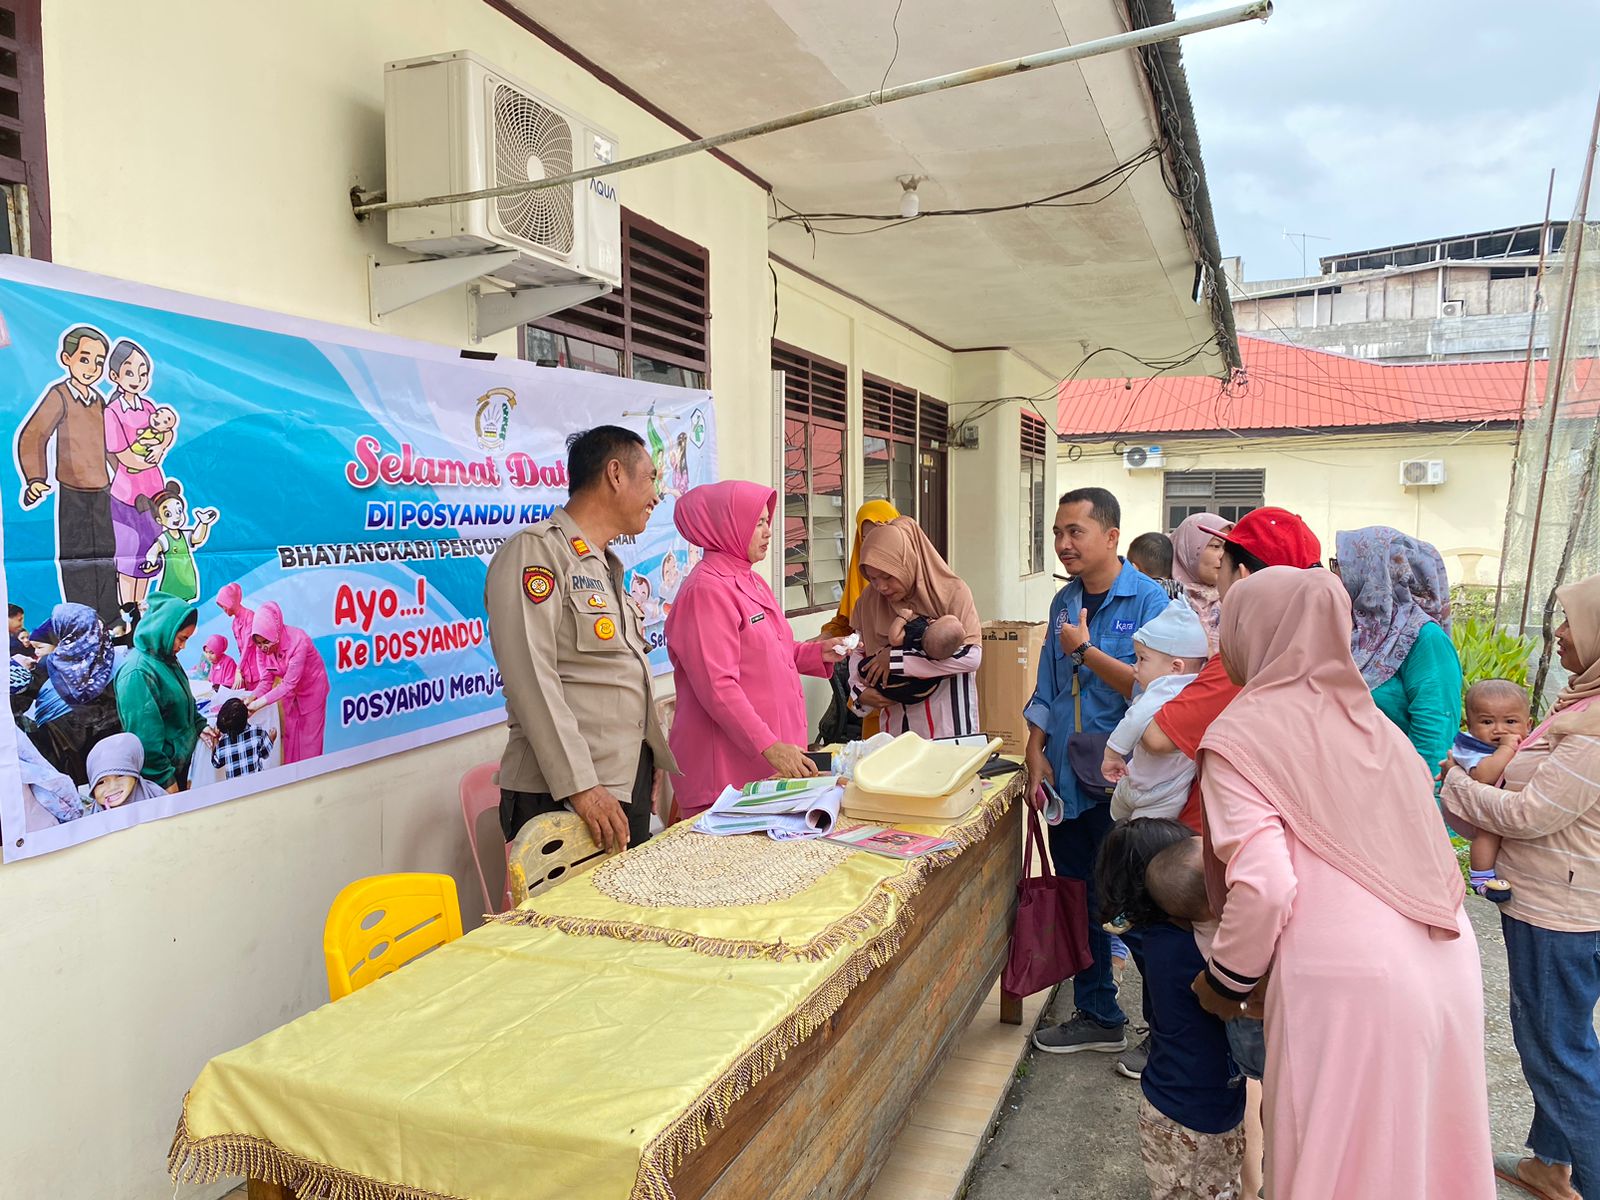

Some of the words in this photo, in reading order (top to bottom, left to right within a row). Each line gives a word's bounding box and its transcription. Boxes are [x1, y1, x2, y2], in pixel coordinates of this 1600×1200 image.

[590, 177, 616, 202] AQUA
[346, 435, 500, 487] Selamat
[505, 452, 569, 487] Dat
[367, 503, 393, 527] DI
[401, 503, 515, 527] POSYANDU
[519, 504, 563, 523] KEM
[278, 541, 434, 567] BHAYANGKARI
[338, 640, 367, 669] Ke
[375, 620, 482, 662] POSYANDU
[343, 678, 444, 725] POSYANDU
